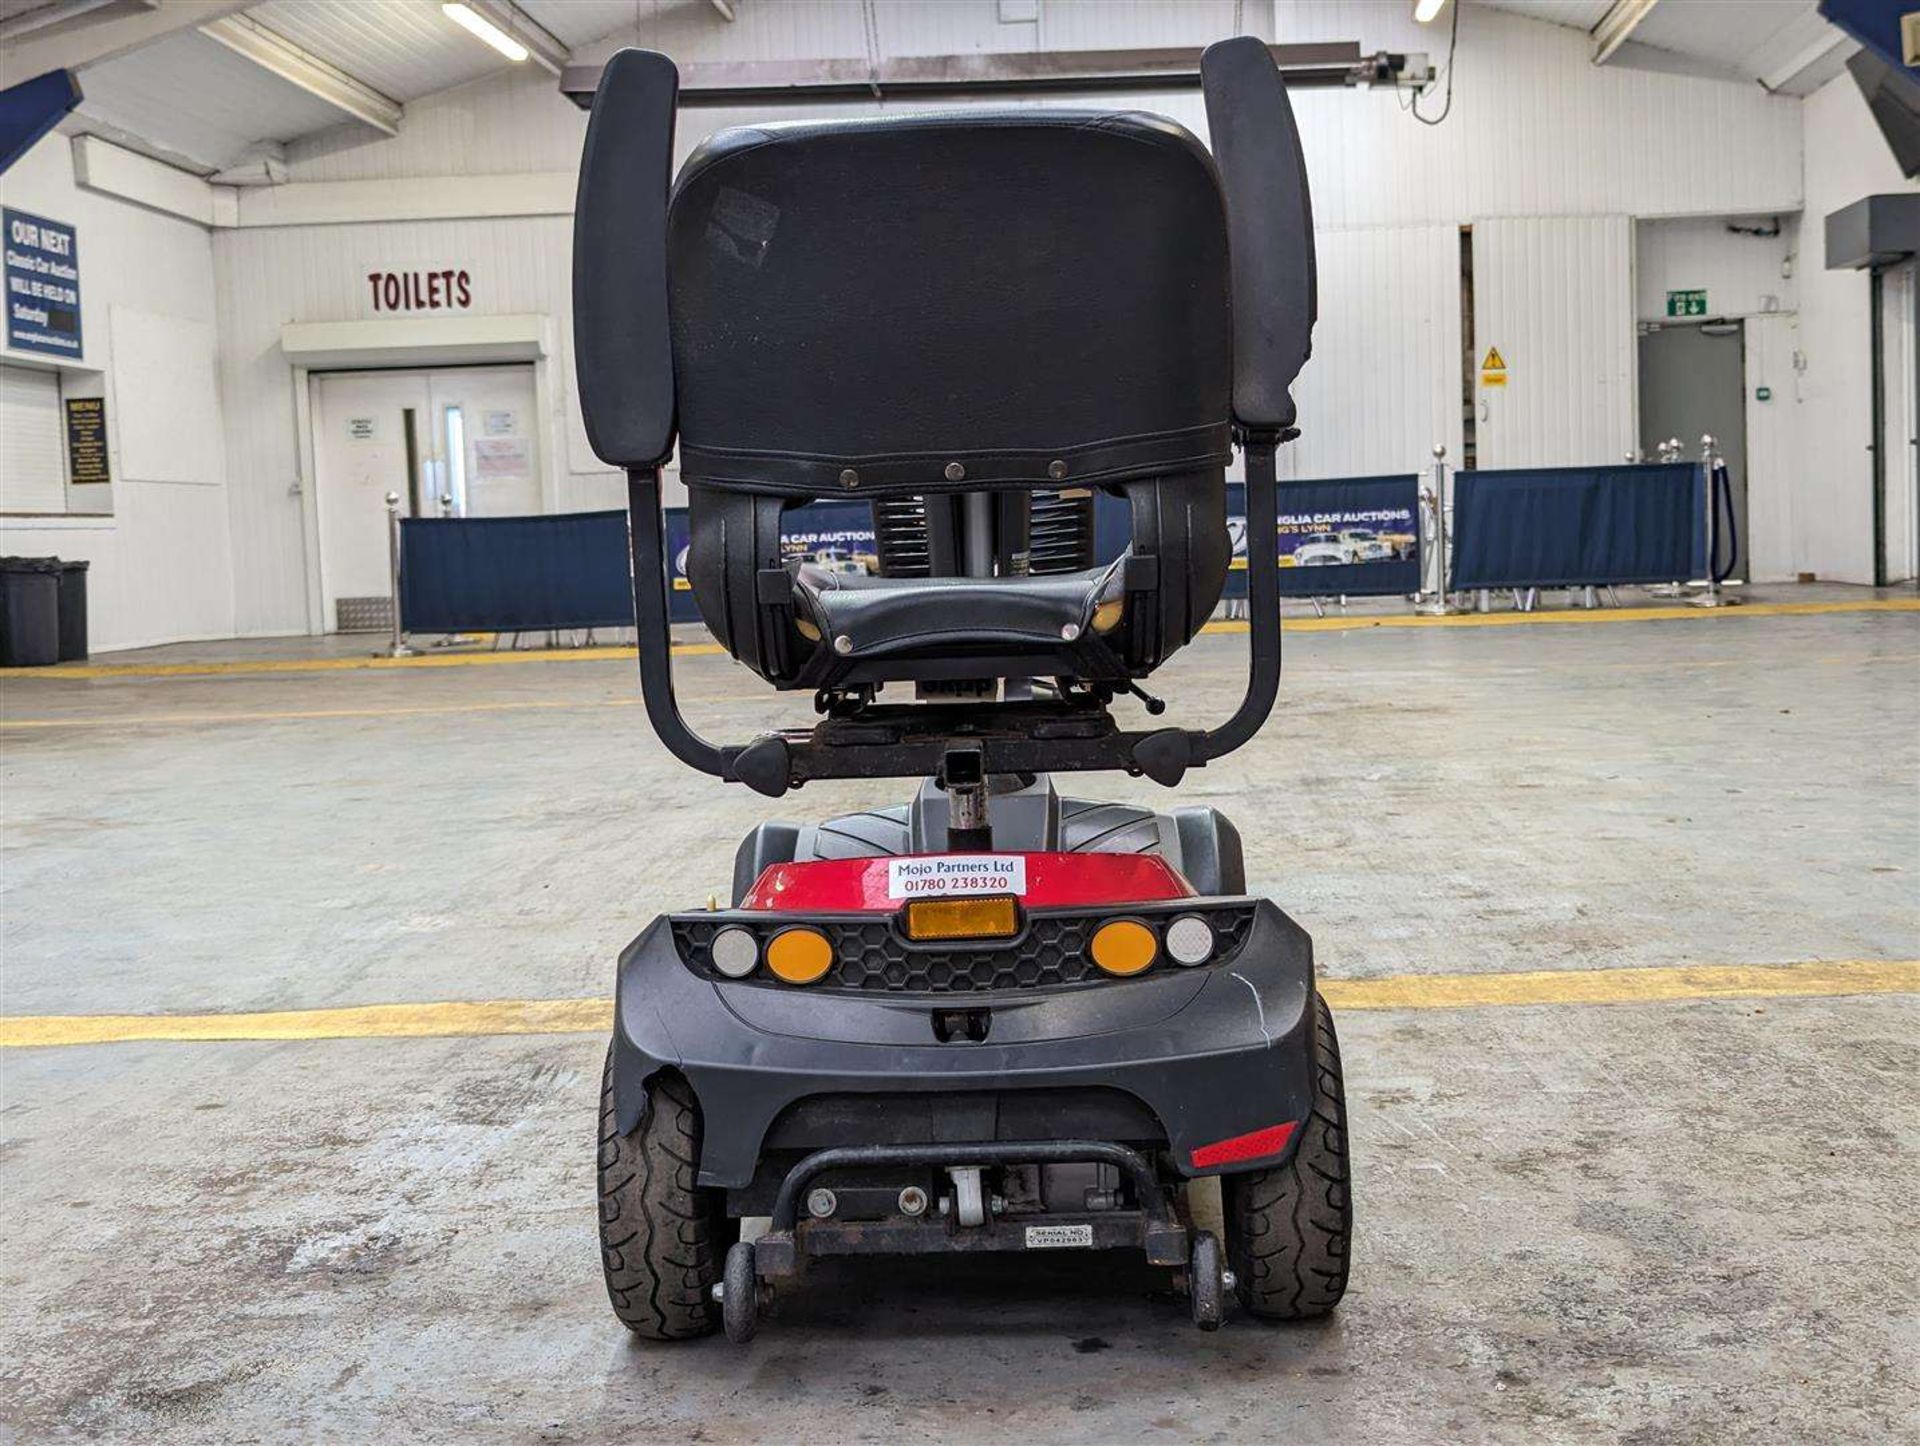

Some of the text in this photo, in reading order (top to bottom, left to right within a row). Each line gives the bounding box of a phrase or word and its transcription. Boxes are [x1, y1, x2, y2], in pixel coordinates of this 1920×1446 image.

[11, 220, 71, 256] OUR NEXT
[36, 257, 51, 274] Car
[9, 276, 77, 306] WILL BE HELD ON
[368, 270, 472, 311] TOILETS
[1277, 509, 1411, 525] GLIA CAR AUCTIONS
[790, 533, 819, 544] CAR
[819, 530, 876, 542] AUCTION
[1277, 523, 1331, 535] G'S LYNN
[781, 543, 808, 554] LYNN
[898, 860, 1015, 877] Mojo Partners Ltd
[904, 876, 1008, 892] 01780 238320
